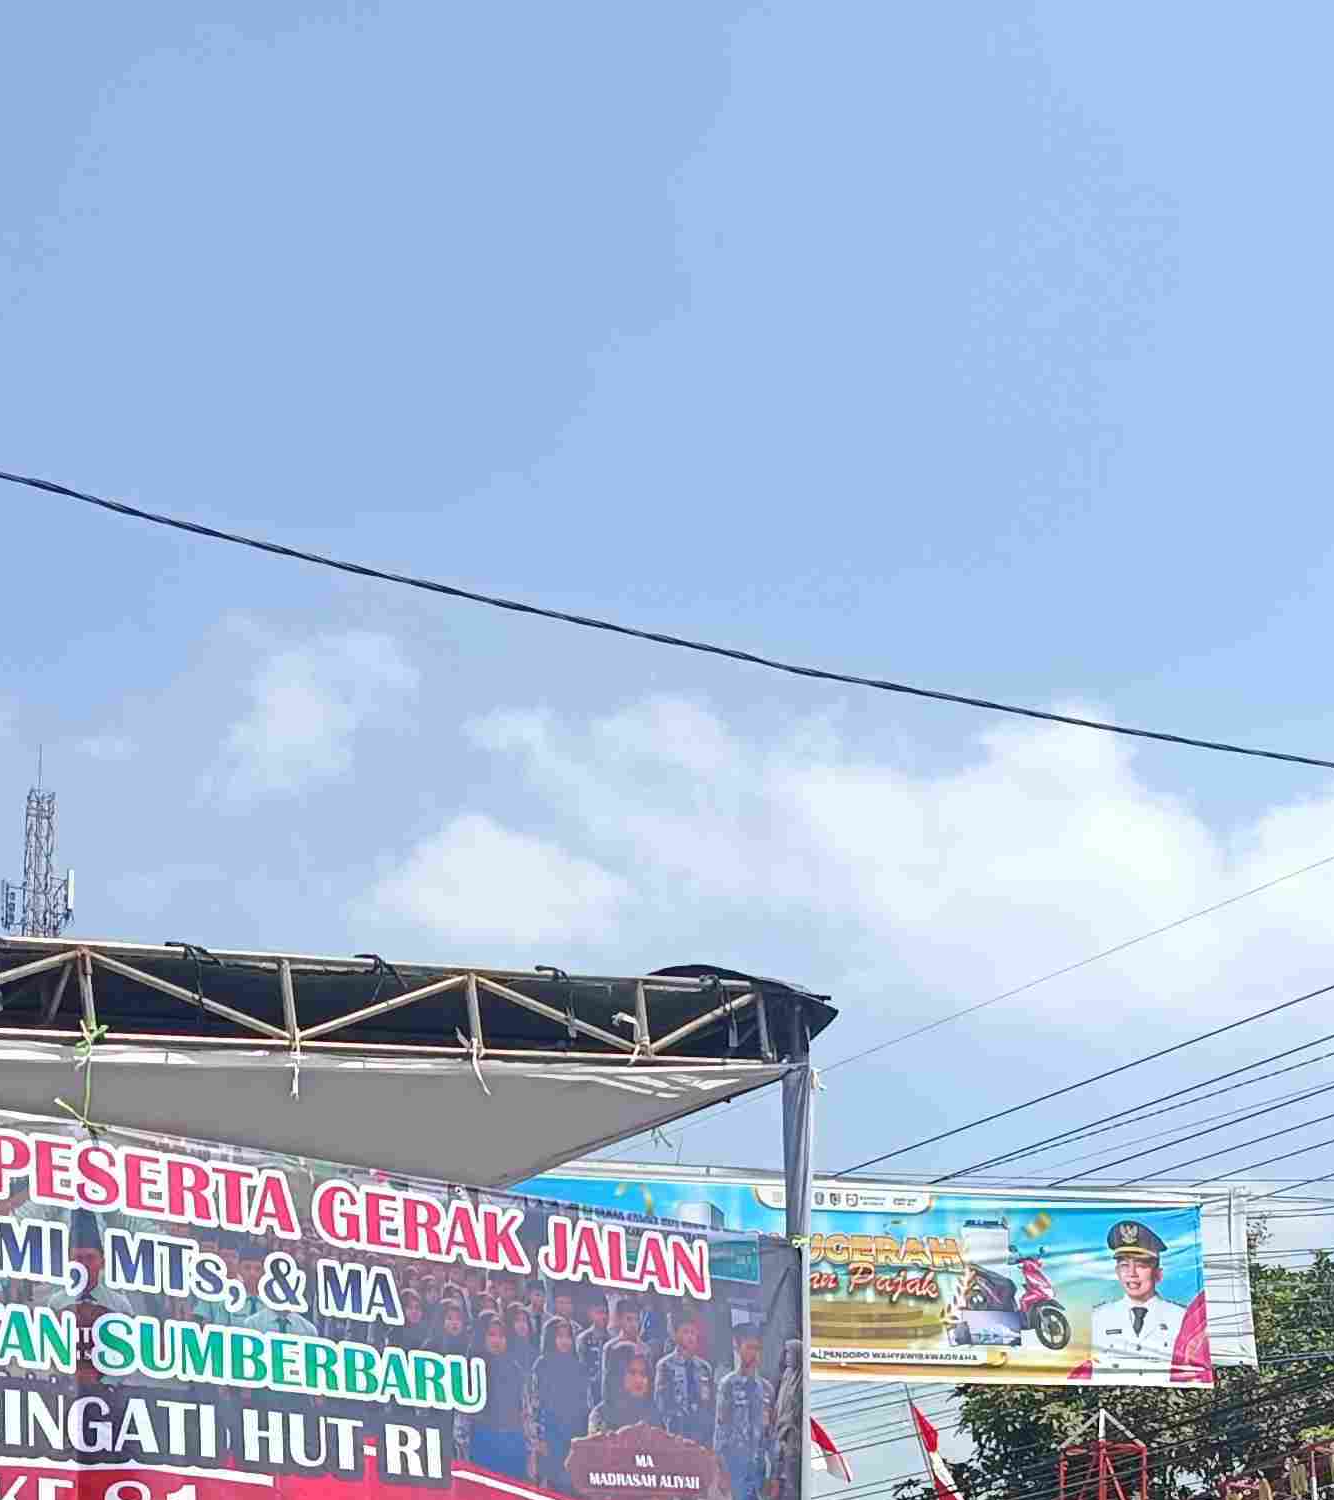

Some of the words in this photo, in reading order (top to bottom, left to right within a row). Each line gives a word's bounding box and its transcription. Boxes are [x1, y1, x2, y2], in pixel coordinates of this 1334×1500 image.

[314, 1184, 523, 1284] GERAK
[535, 1212, 712, 1300] JALAN
[811, 1231, 964, 1266] UGERAH
[105, 1238, 244, 1313] MTs,
[259, 1262, 308, 1311] &
[315, 1262, 405, 1327] MA
[846, 1262, 941, 1305] Pajak
[89, 1312, 489, 1416] SUMBERBARU
[243, 1410, 445, 1482] HUT-RI
[635, 1453, 655, 1469] MA
[588, 1472, 656, 1491] MADRASAH
[658, 1474, 701, 1491] ALIYAH
